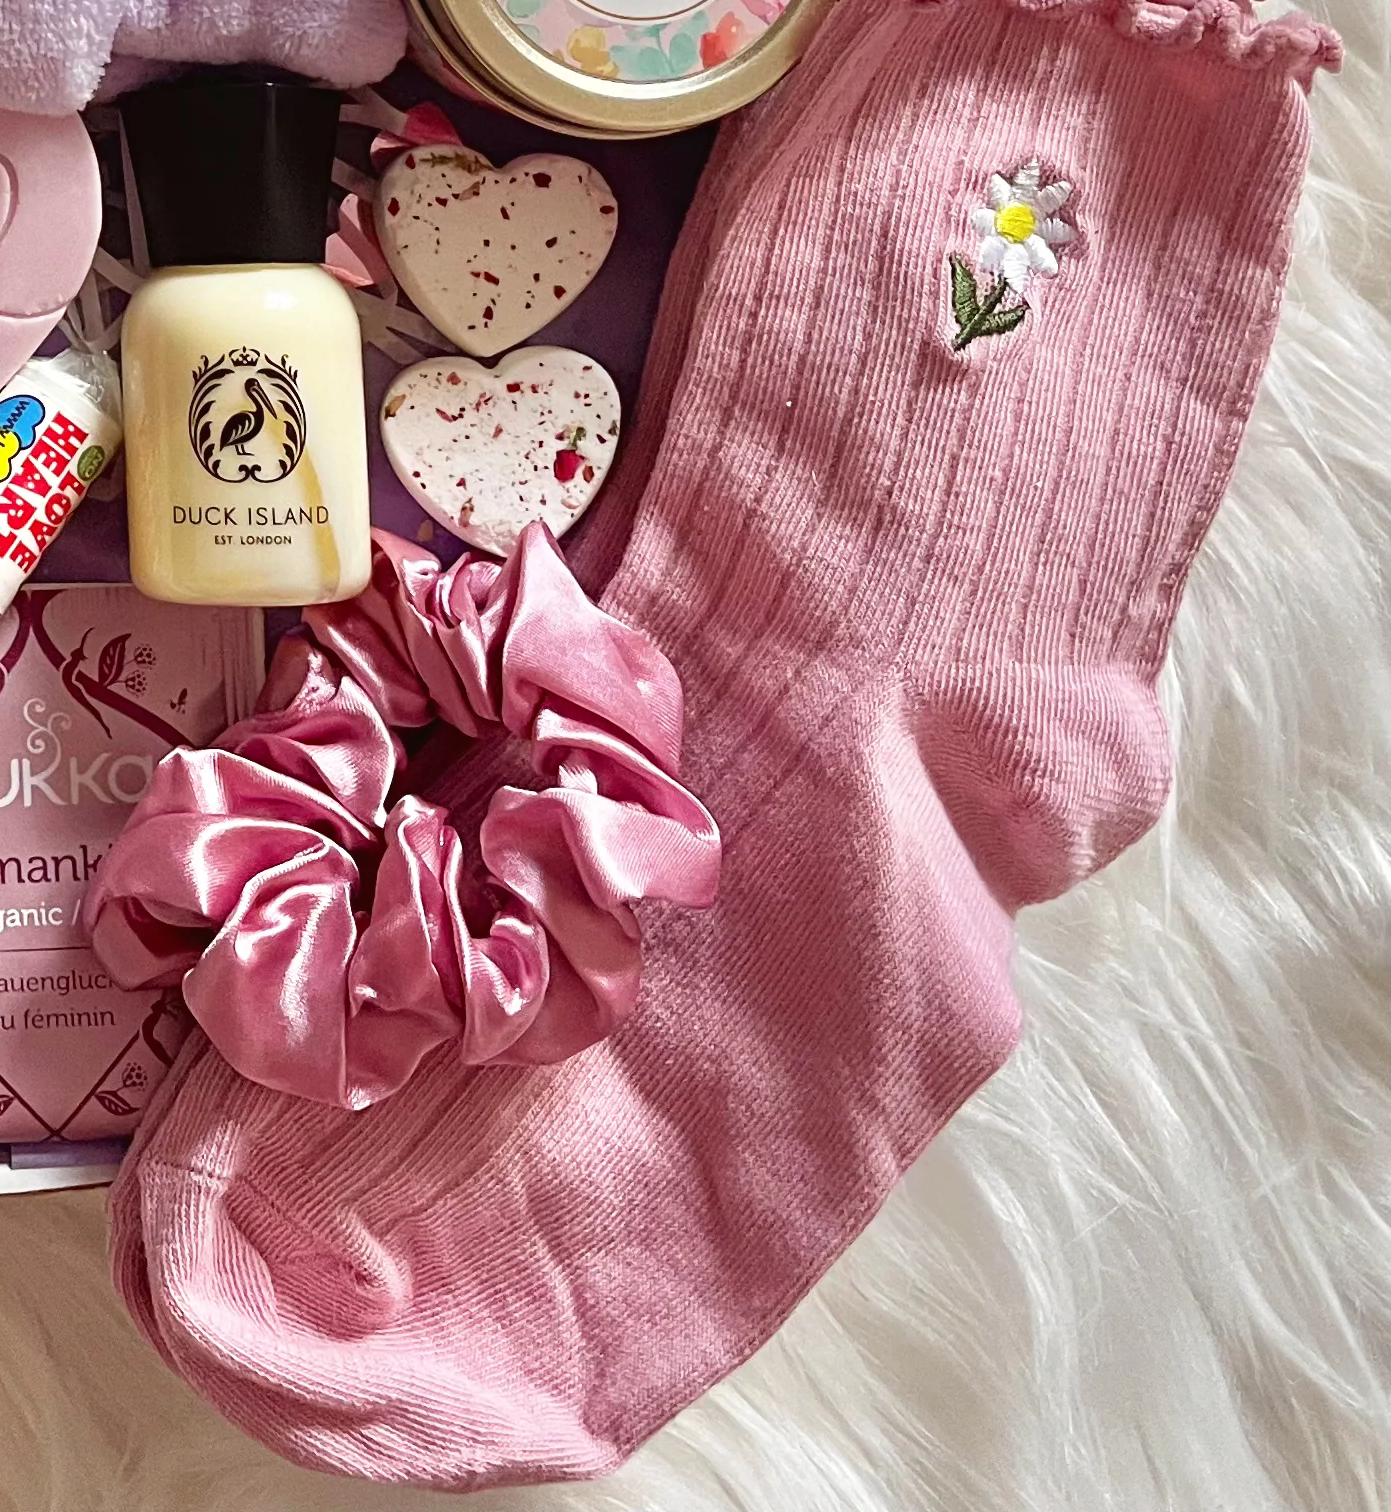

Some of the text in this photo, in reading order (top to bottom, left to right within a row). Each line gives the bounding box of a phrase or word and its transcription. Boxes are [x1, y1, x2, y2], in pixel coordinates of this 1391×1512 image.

[9, 469, 87, 574] LOVE
[172, 505, 330, 526] DUCK ISLAND
[240, 535, 293, 546] LONDON
[23, 1006, 117, 1030] féminin
